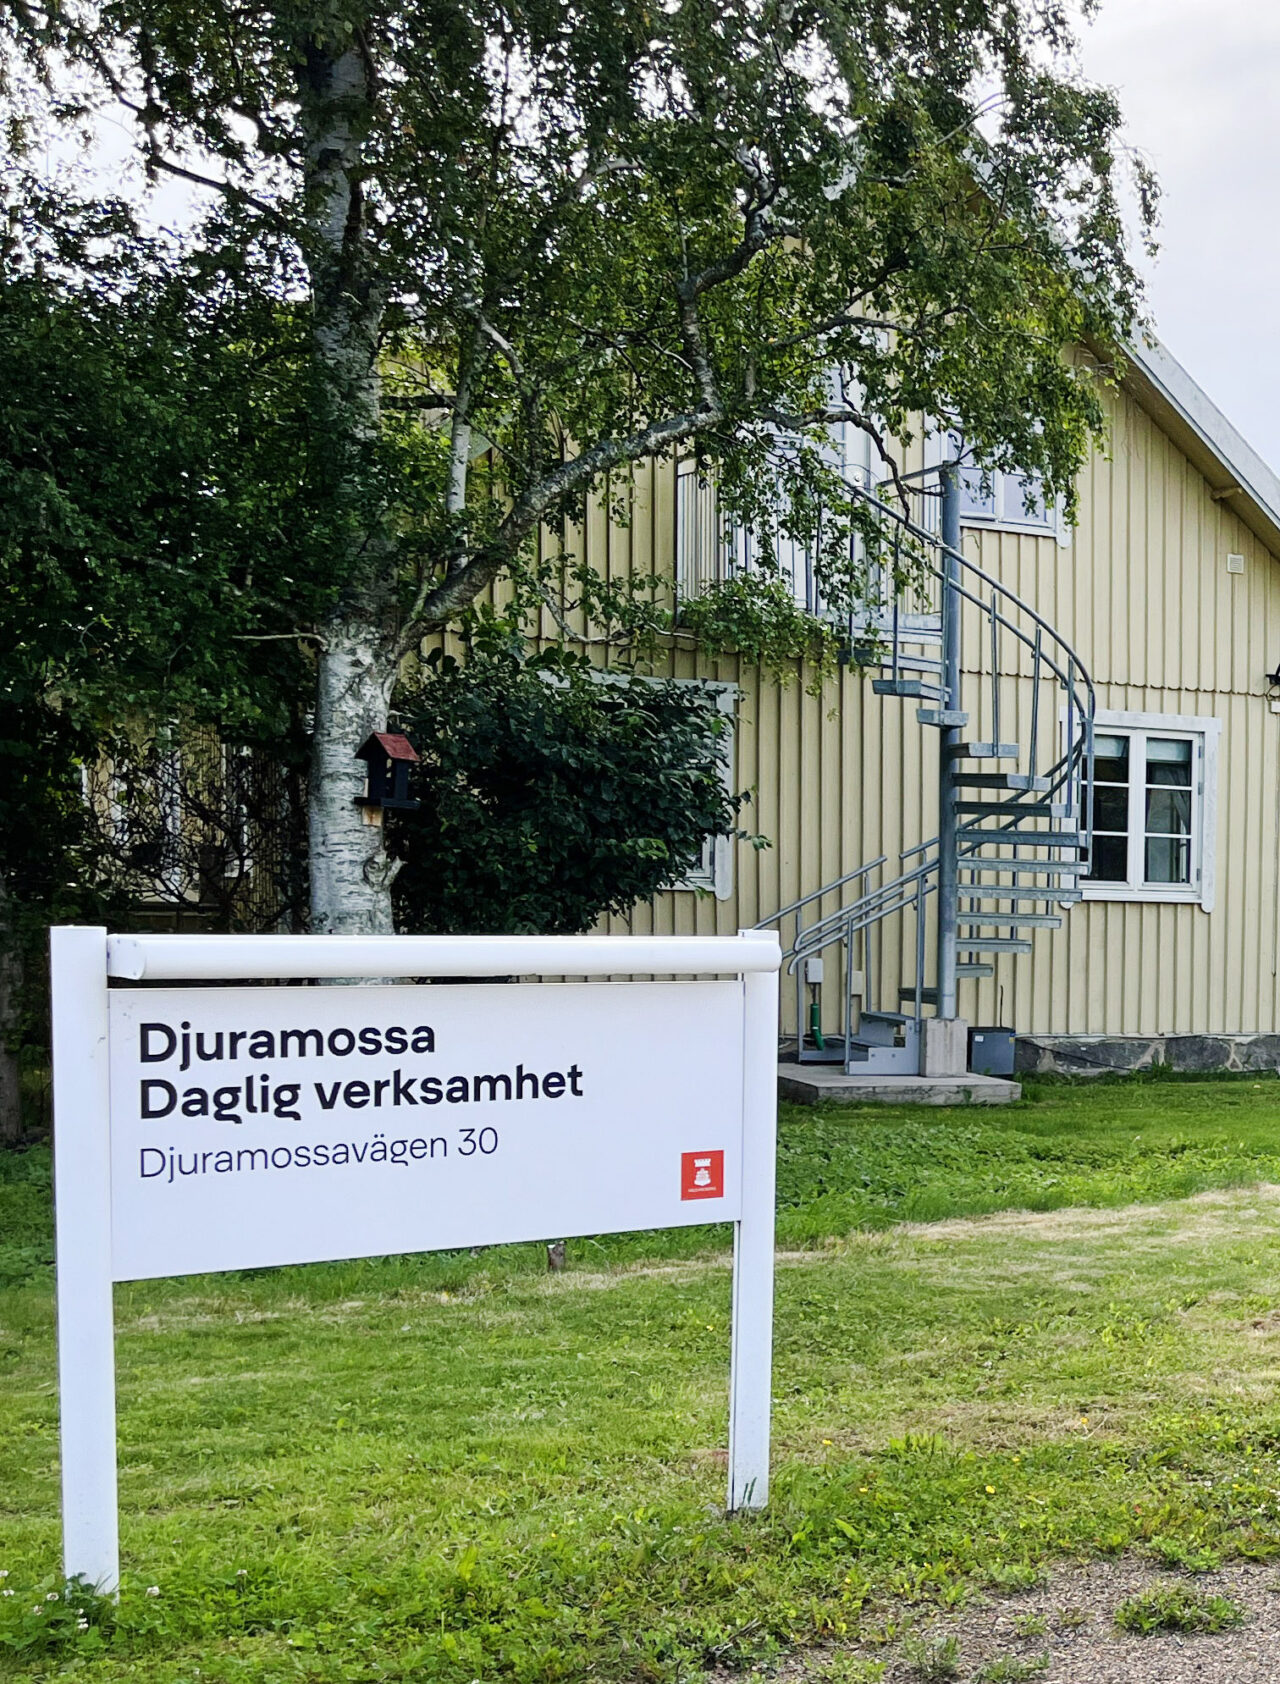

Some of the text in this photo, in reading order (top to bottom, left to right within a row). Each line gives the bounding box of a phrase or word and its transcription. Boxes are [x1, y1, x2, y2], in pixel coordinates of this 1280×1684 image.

[139, 1021, 436, 1072] Djuramossa
[140, 1063, 584, 1125] Daglig verksamhet
[139, 1126, 499, 1184] Djuramossavägen 30
